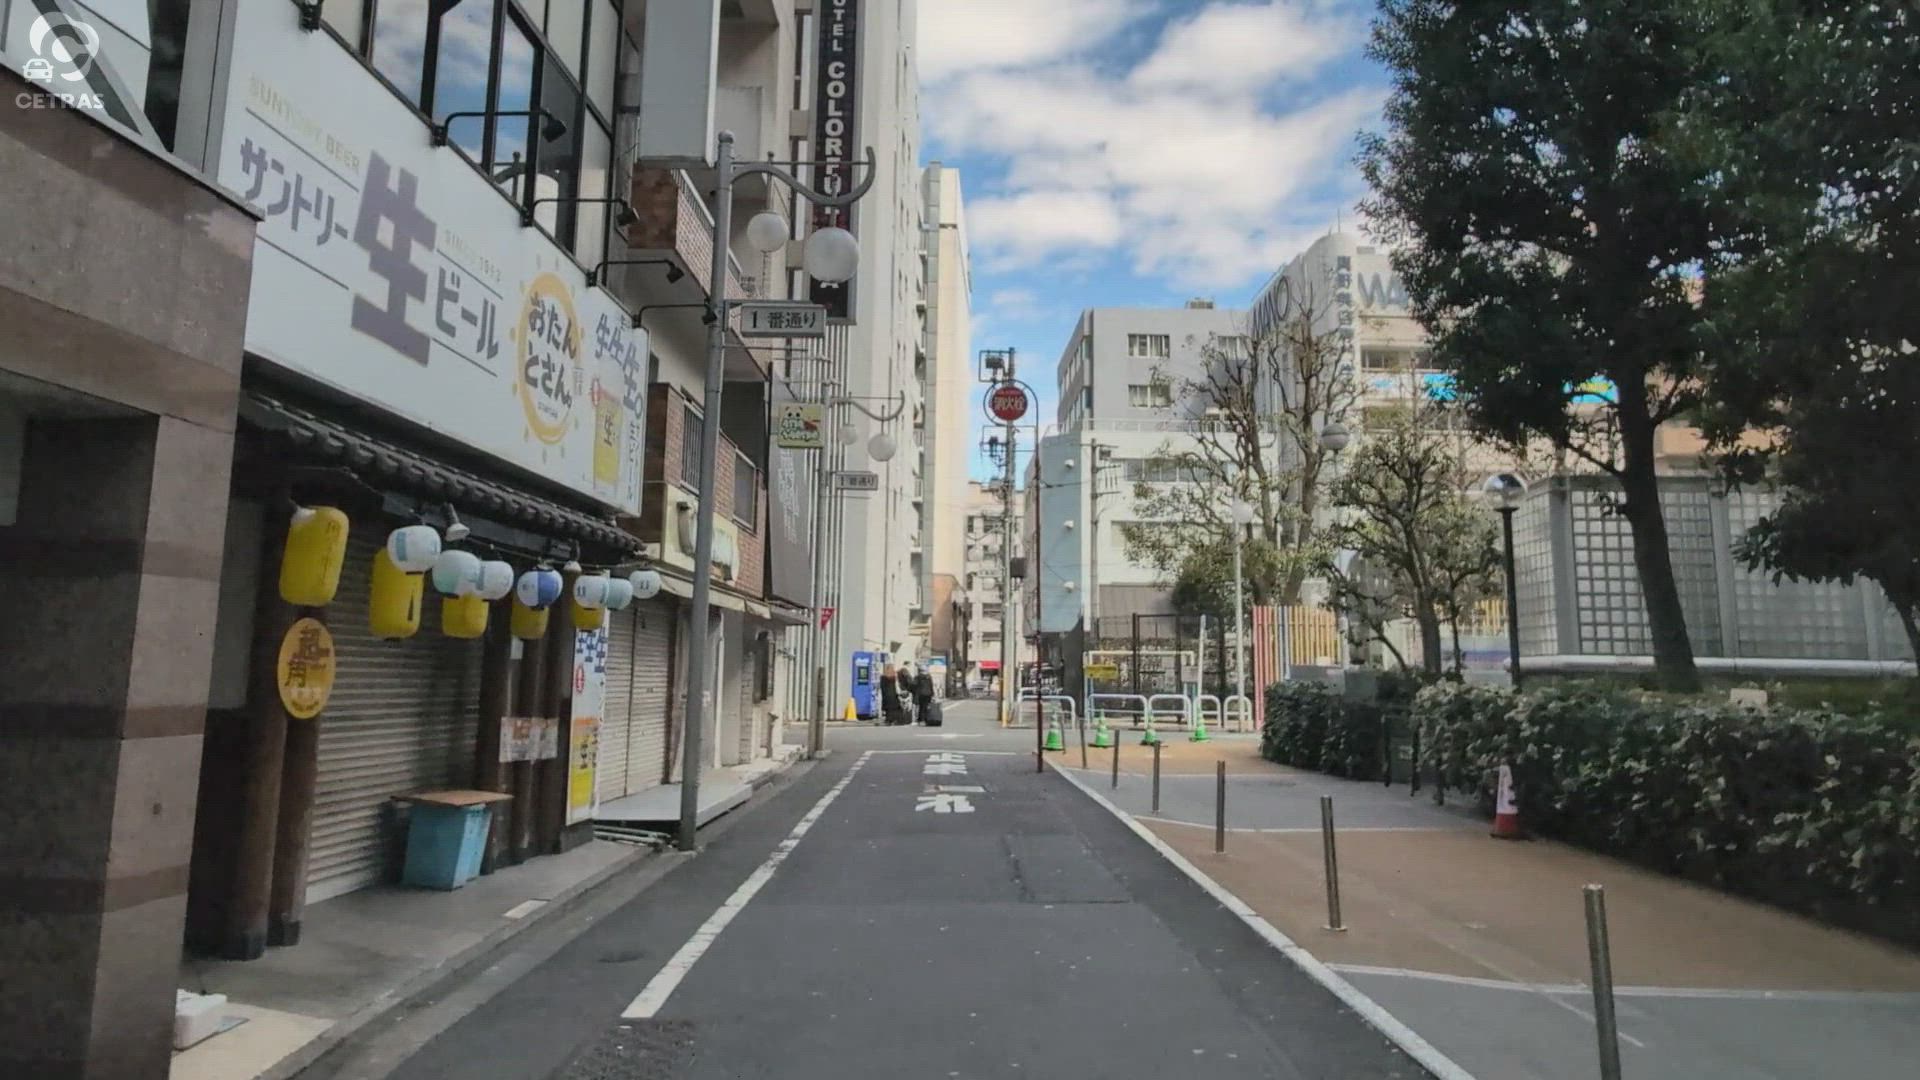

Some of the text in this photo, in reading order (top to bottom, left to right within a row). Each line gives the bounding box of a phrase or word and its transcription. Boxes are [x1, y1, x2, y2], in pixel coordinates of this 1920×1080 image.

[240, 137, 500, 367] サントリー 生 ビール
[528, 291, 577, 360] おたん
[994, 396, 1025, 411] 消火栓
